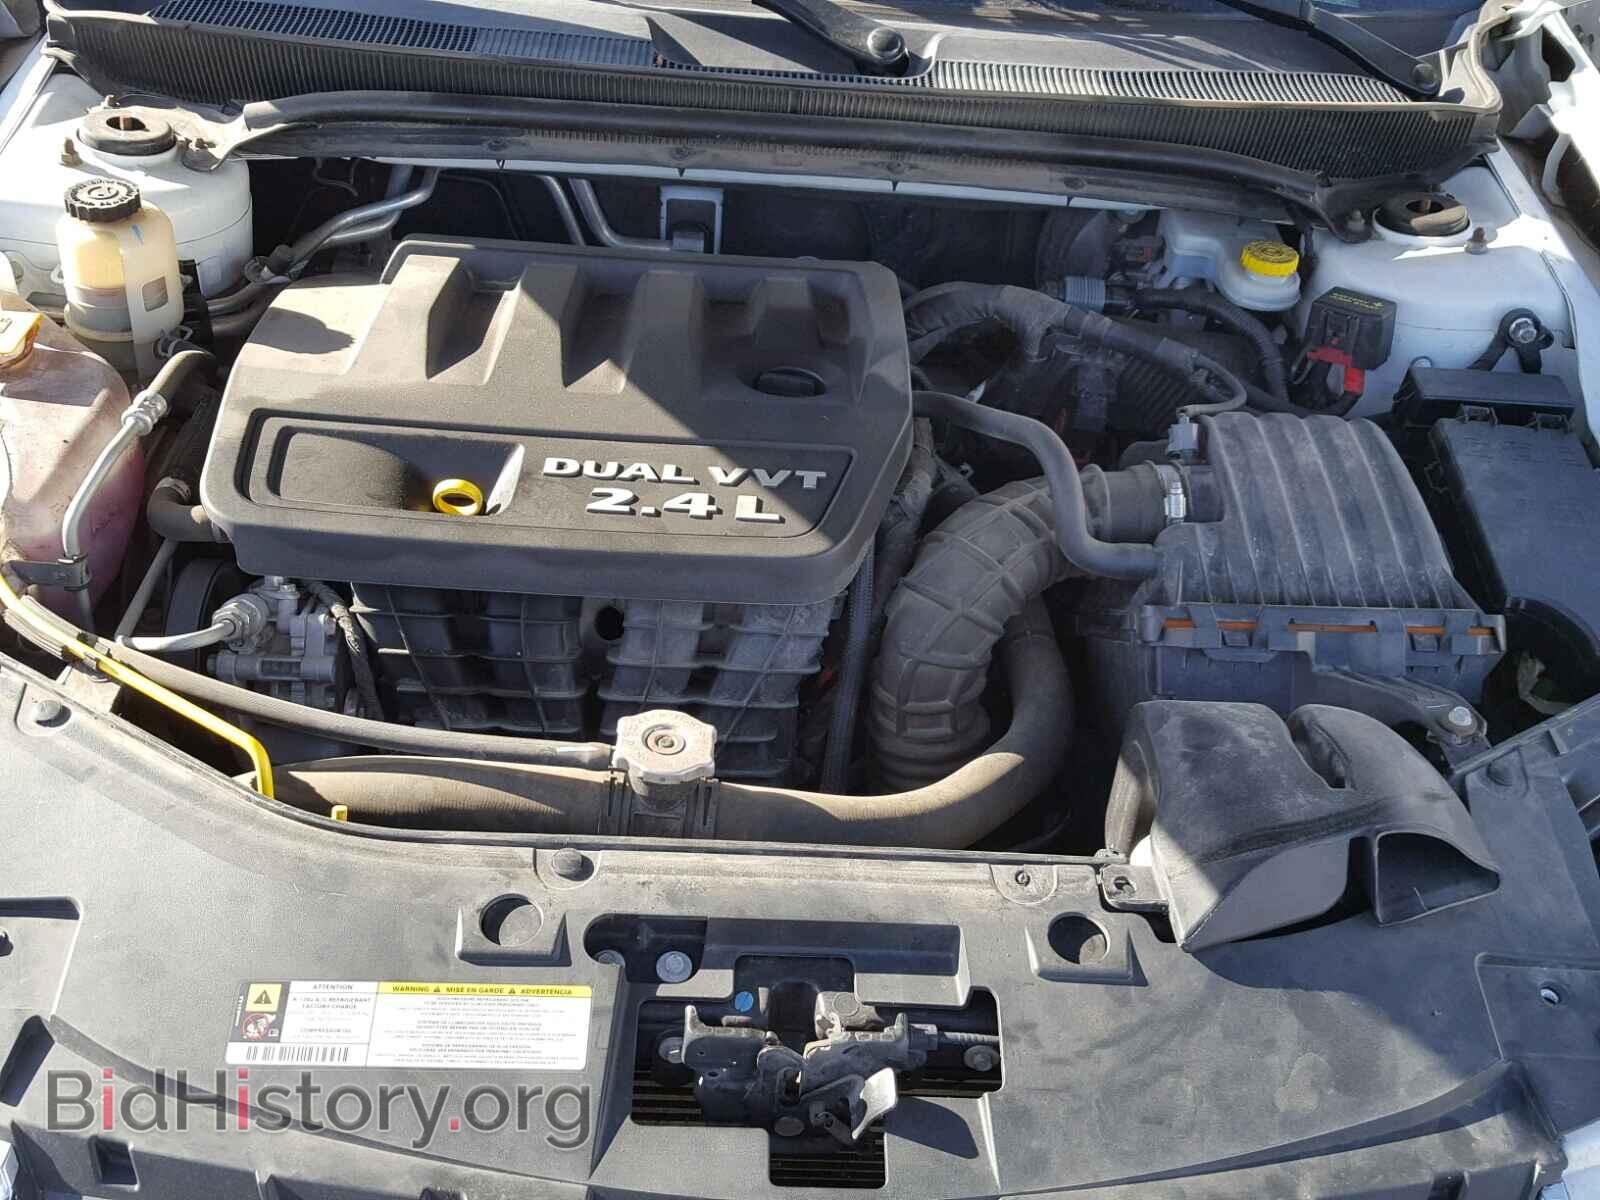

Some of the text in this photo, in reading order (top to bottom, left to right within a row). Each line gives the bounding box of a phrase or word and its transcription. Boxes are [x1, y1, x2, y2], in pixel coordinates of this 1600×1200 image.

[543, 457, 827, 489] DUAL VVT
[393, 985, 430, 993] WARNING
